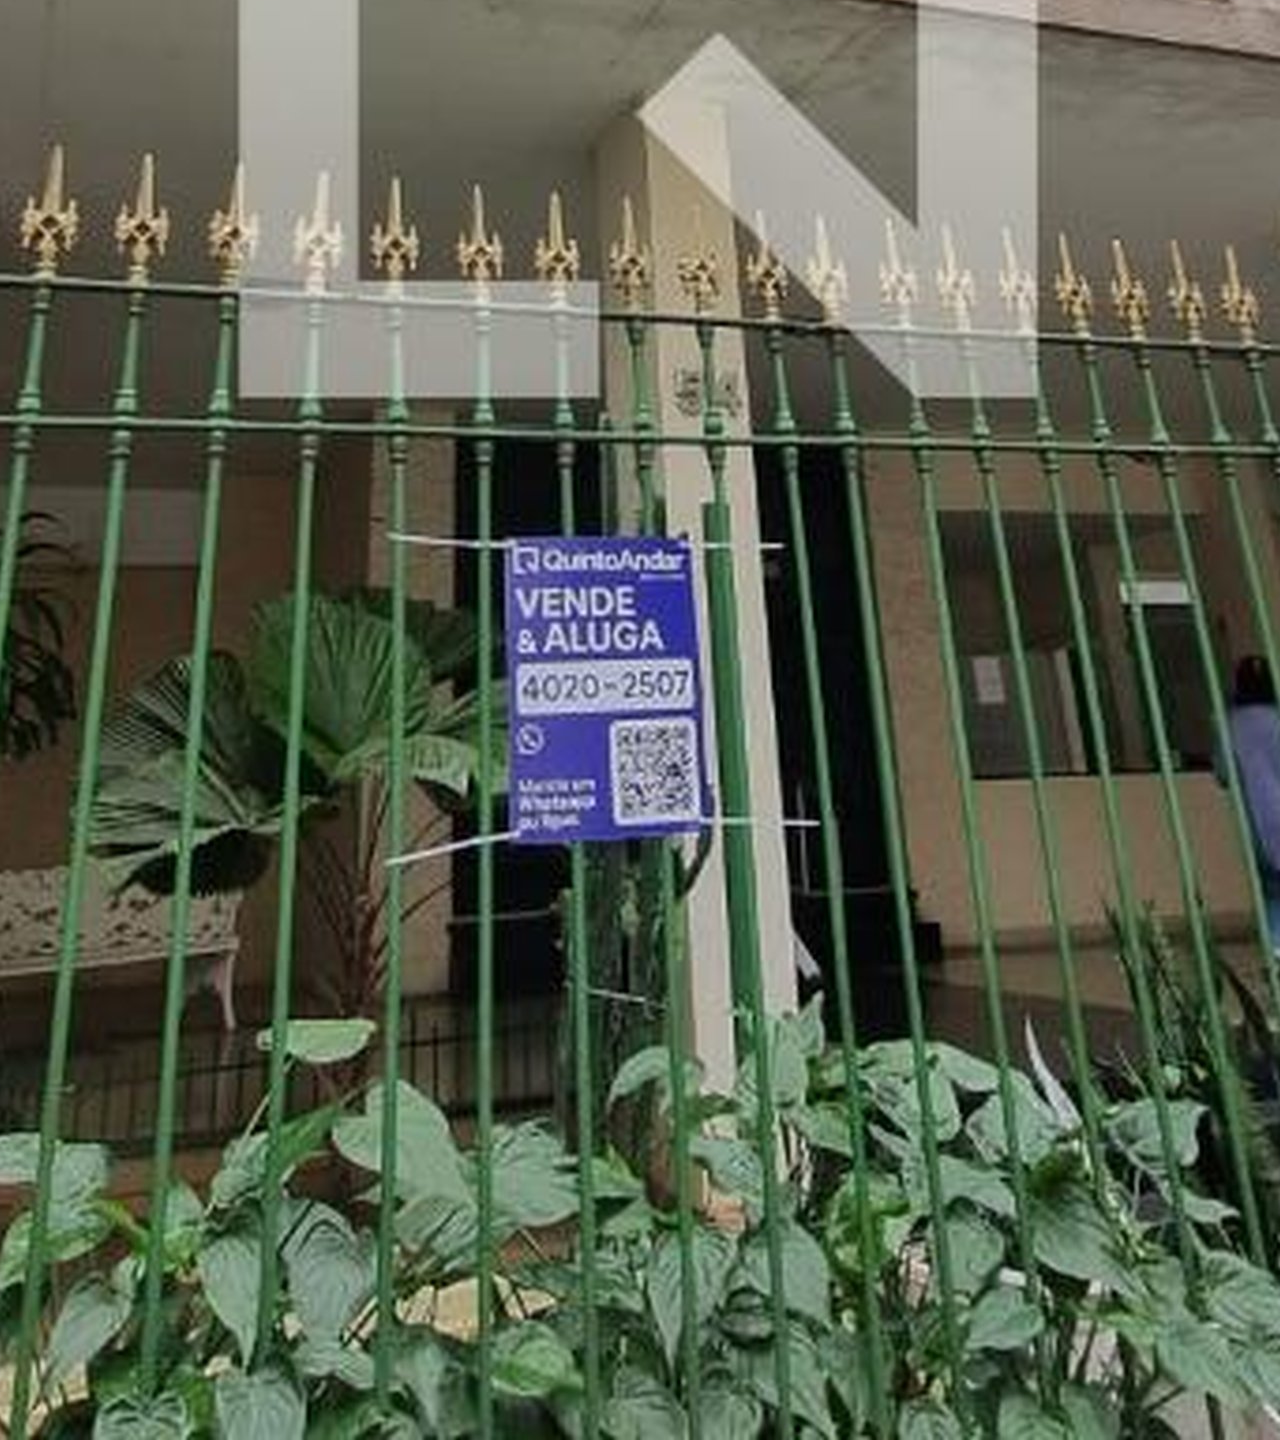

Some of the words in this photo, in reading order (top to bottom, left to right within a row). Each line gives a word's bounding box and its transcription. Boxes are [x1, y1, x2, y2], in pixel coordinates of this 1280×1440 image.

[543, 549, 685, 572] QuintoAndar
[515, 586, 637, 618] VENDE
[516, 629, 537, 653] &
[542, 621, 664, 653] ALUGA
[521, 669, 690, 702] 4020-2507
